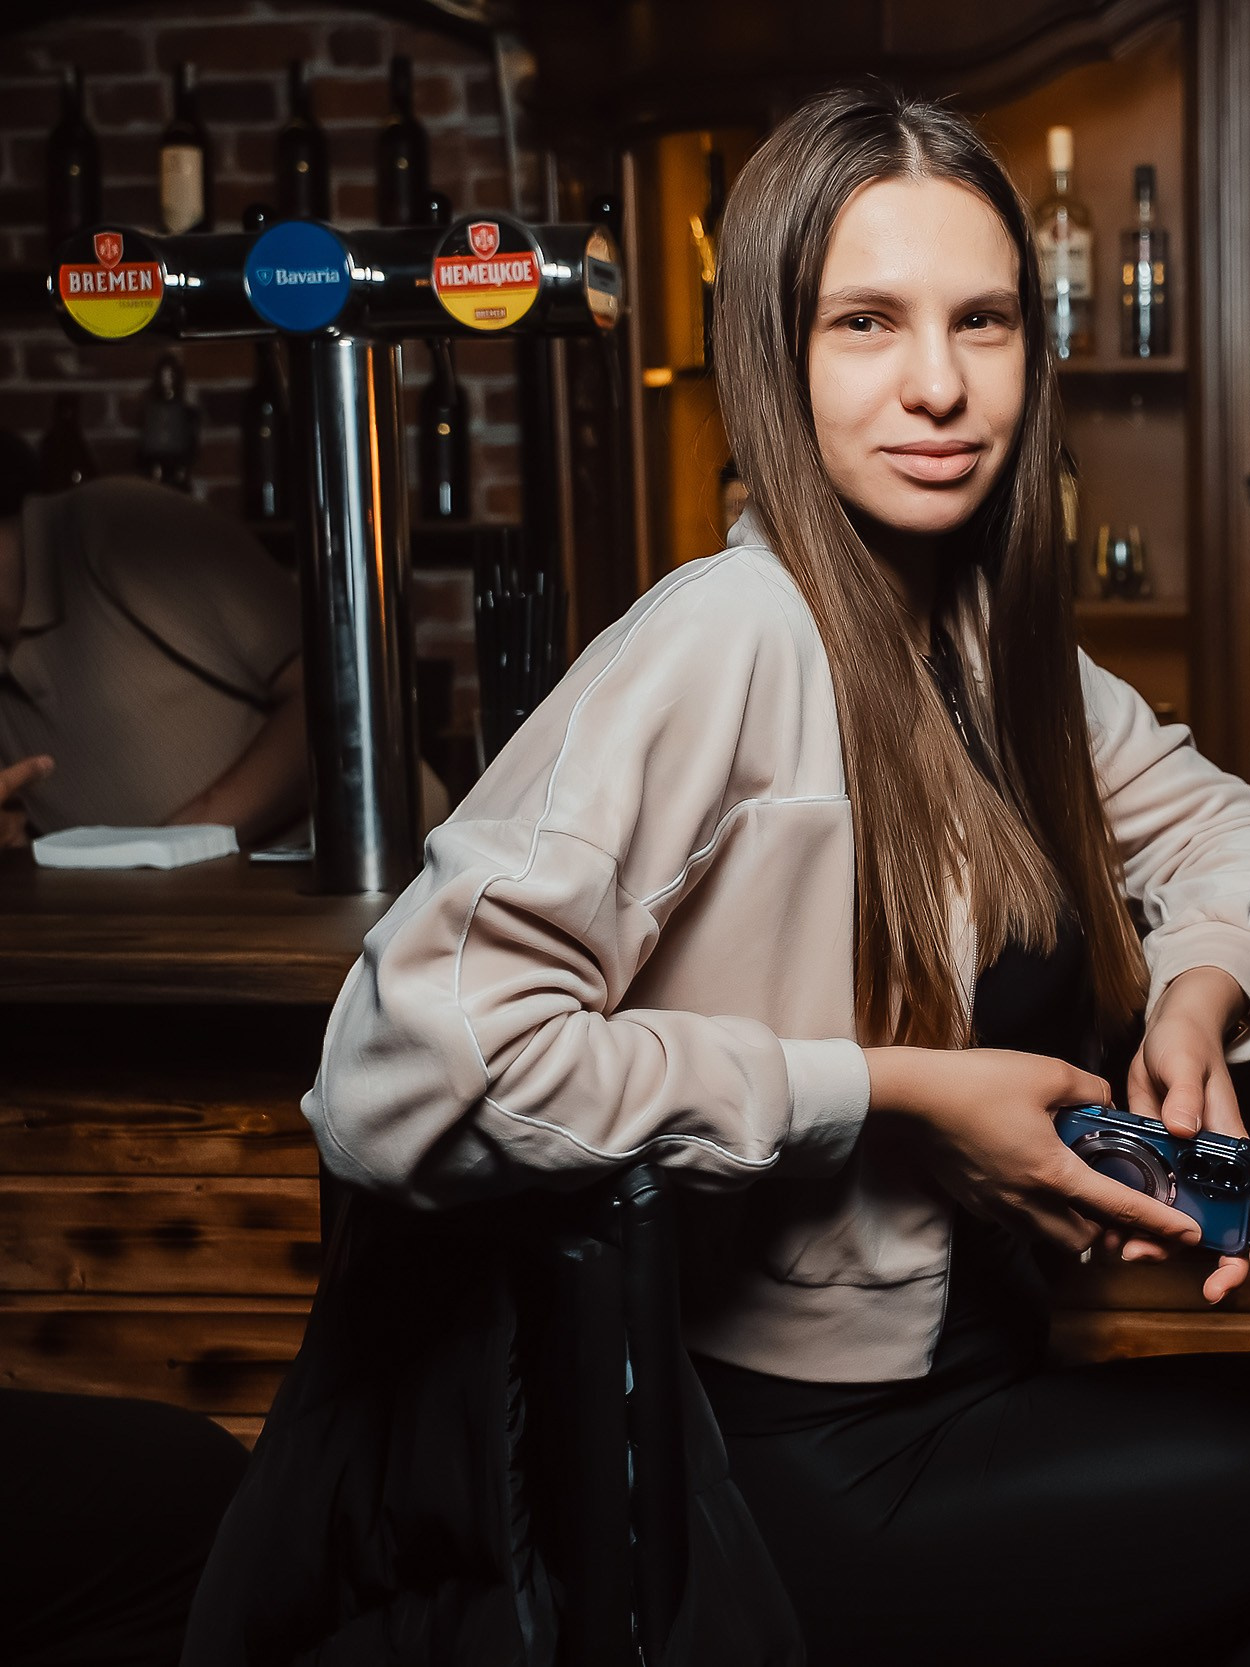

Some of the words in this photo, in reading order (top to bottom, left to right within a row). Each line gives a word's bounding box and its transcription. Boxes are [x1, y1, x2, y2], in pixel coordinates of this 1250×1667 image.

[69, 270, 152, 294] BREMEN
[275, 267, 340, 286] Bavaria
[440, 260, 533, 288] НЕМЕЦКОЕ
